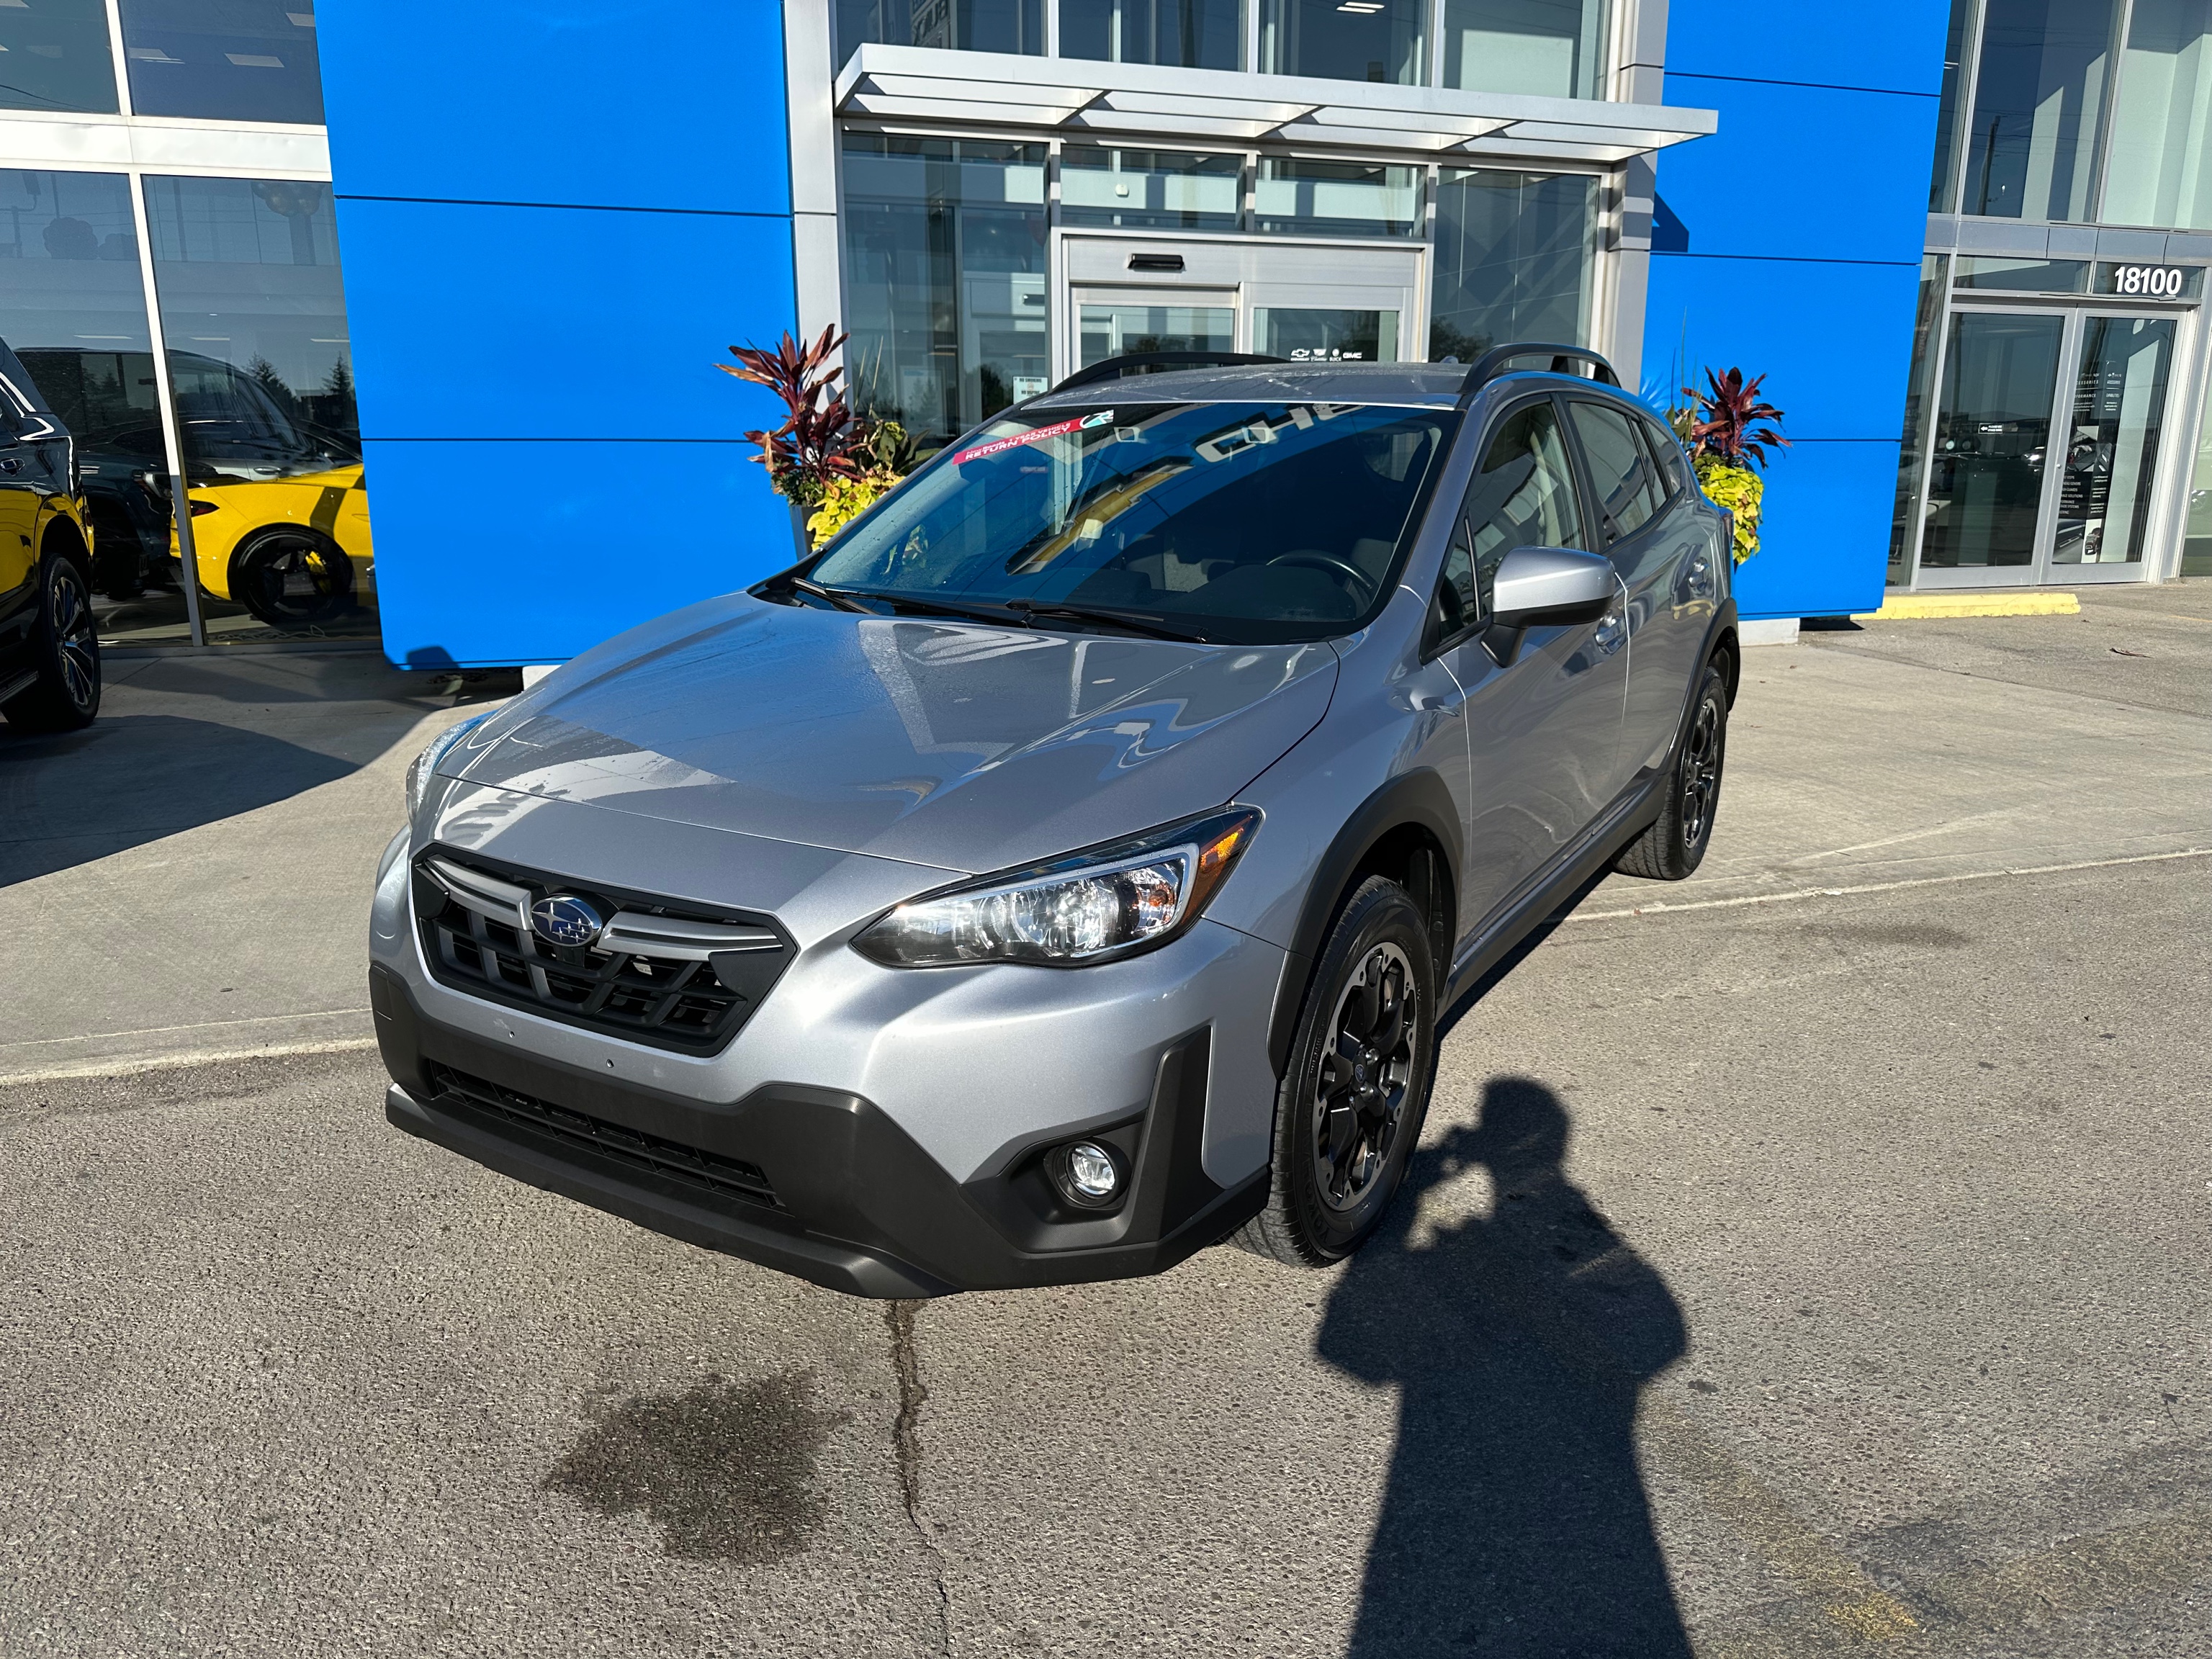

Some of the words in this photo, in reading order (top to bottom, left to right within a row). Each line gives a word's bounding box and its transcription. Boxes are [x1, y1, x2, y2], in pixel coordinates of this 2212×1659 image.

[2115, 266, 2182, 295] 18100
[965, 440, 1017, 460] RETURN
[1022, 426, 1071, 443] POLICY
[1038, 423, 1071, 434] VEHICLE
